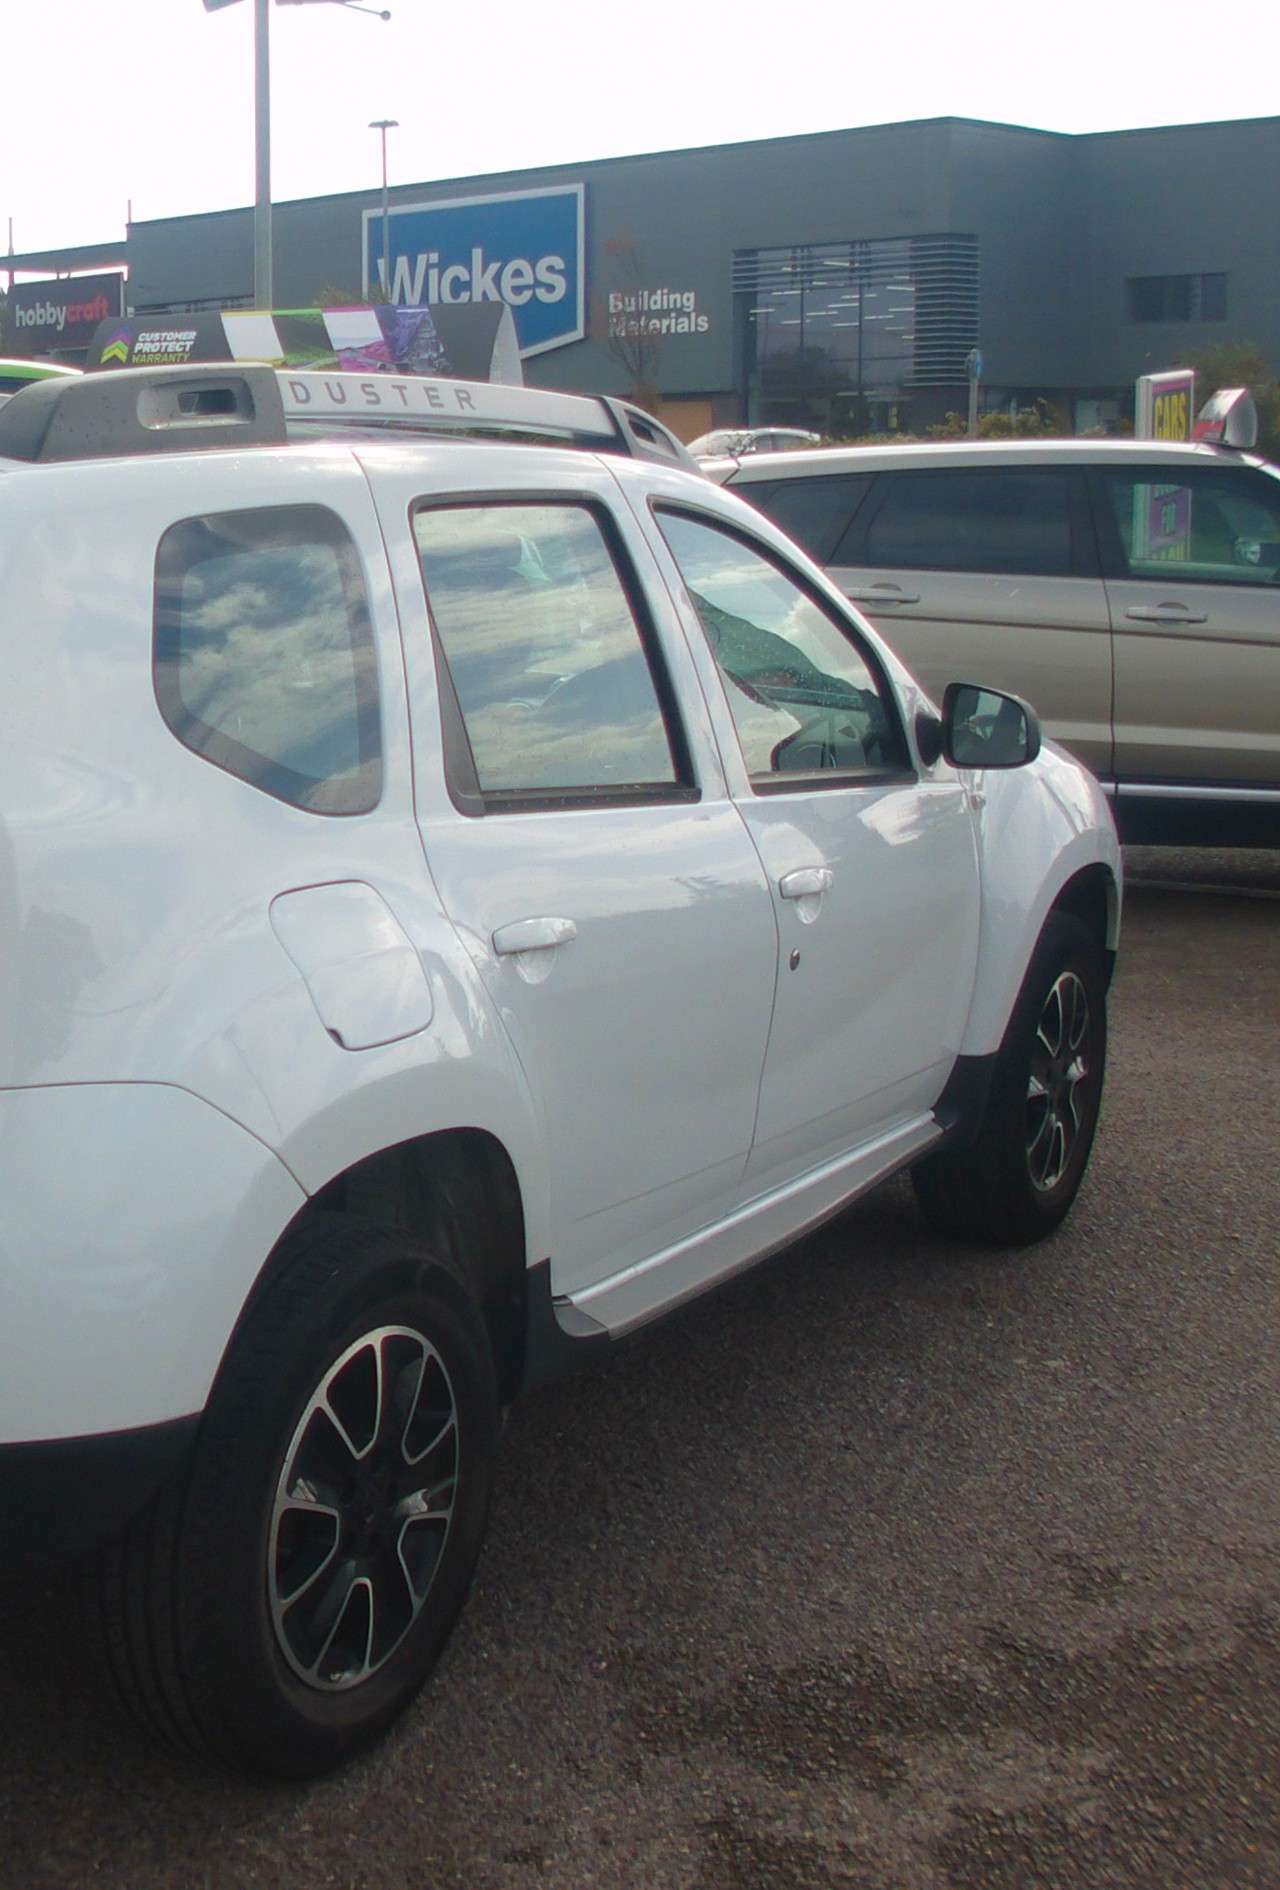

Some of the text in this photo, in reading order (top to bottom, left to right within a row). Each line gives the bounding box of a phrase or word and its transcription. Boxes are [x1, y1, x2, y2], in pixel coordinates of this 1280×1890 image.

[377, 248, 567, 306] Wickes
[15, 296, 108, 331] hobbycraft
[608, 288, 695, 314] Building
[134, 340, 195, 354] PROTECT
[138, 330, 197, 342] CUSTOMER
[131, 352, 191, 364] WARRANTY
[287, 380, 477, 411] DUSTER
